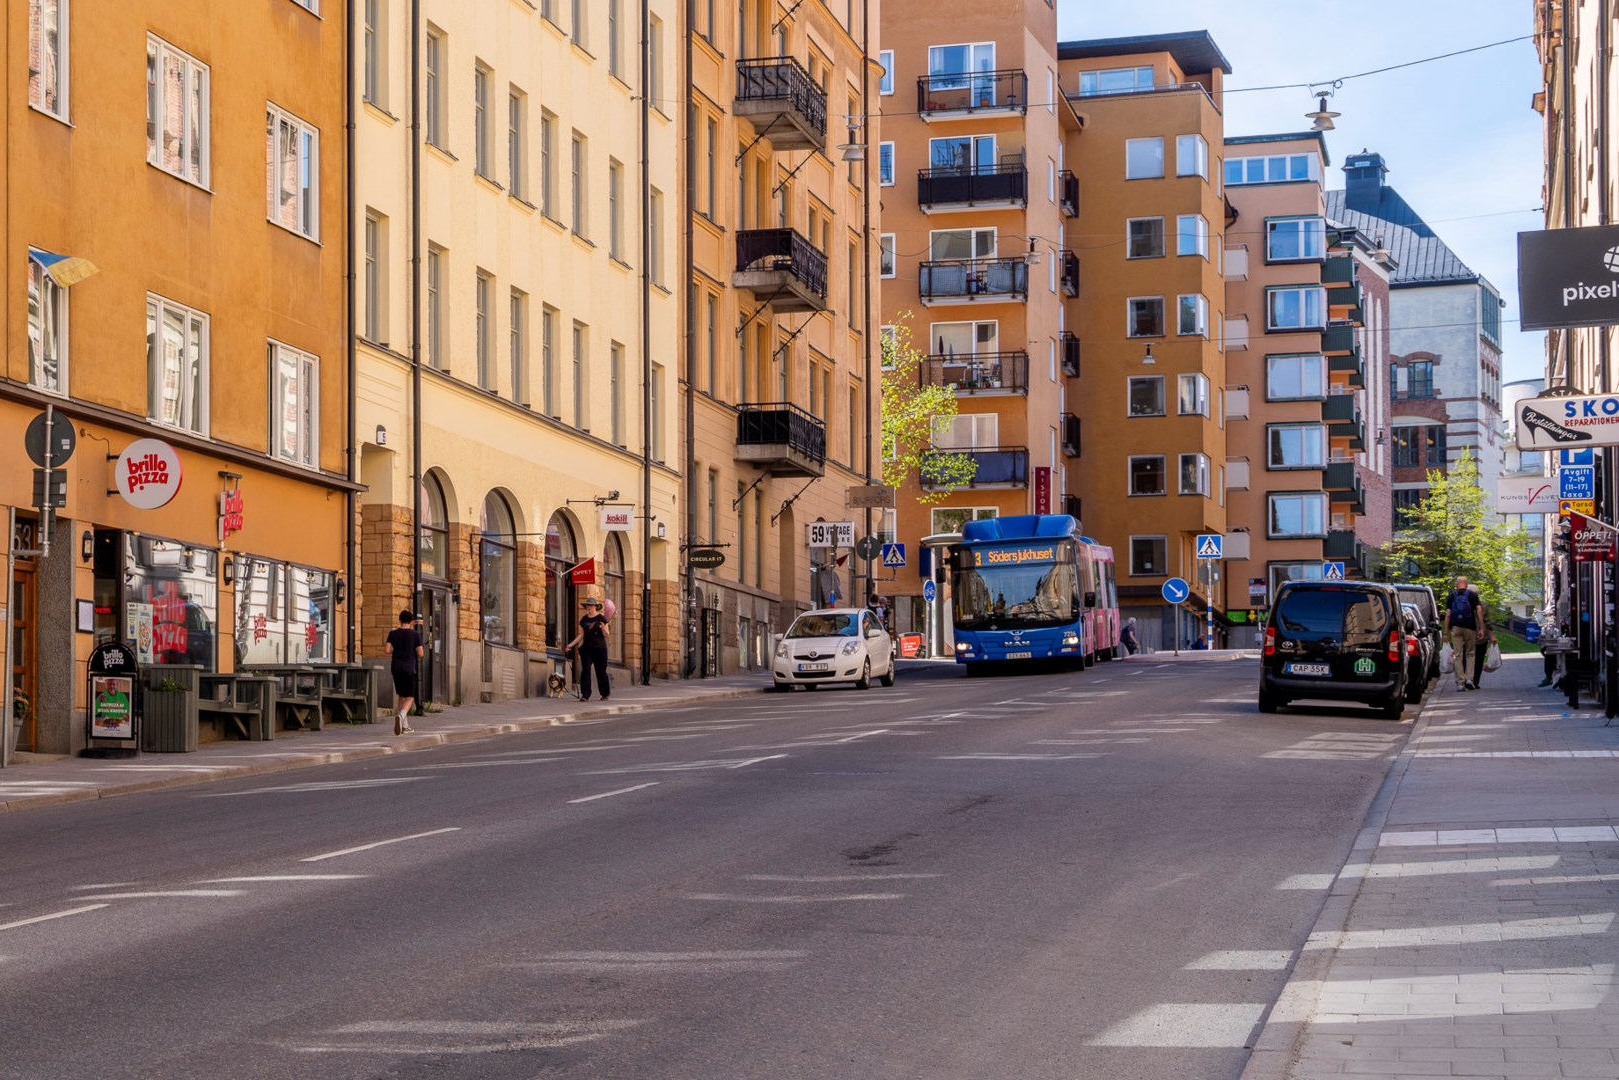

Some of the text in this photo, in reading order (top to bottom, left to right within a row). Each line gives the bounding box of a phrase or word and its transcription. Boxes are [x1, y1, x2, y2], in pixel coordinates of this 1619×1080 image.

[1563, 280, 1619, 306] pixel
[1564, 398, 1619, 418] SKO
[1525, 411, 1579, 440] Beställningar
[127, 454, 167, 475] brillo
[1564, 469, 1590, 477] Avgift
[127, 472, 169, 494] pizza
[222, 489, 244, 515] brillo
[812, 526, 824, 543] 59
[1574, 530, 1612, 540] ÖPPET!
[975, 548, 1053, 566] 3 Södersjukhuset
[103, 649, 124, 660] brillo
[103, 658, 124, 669] pizza
